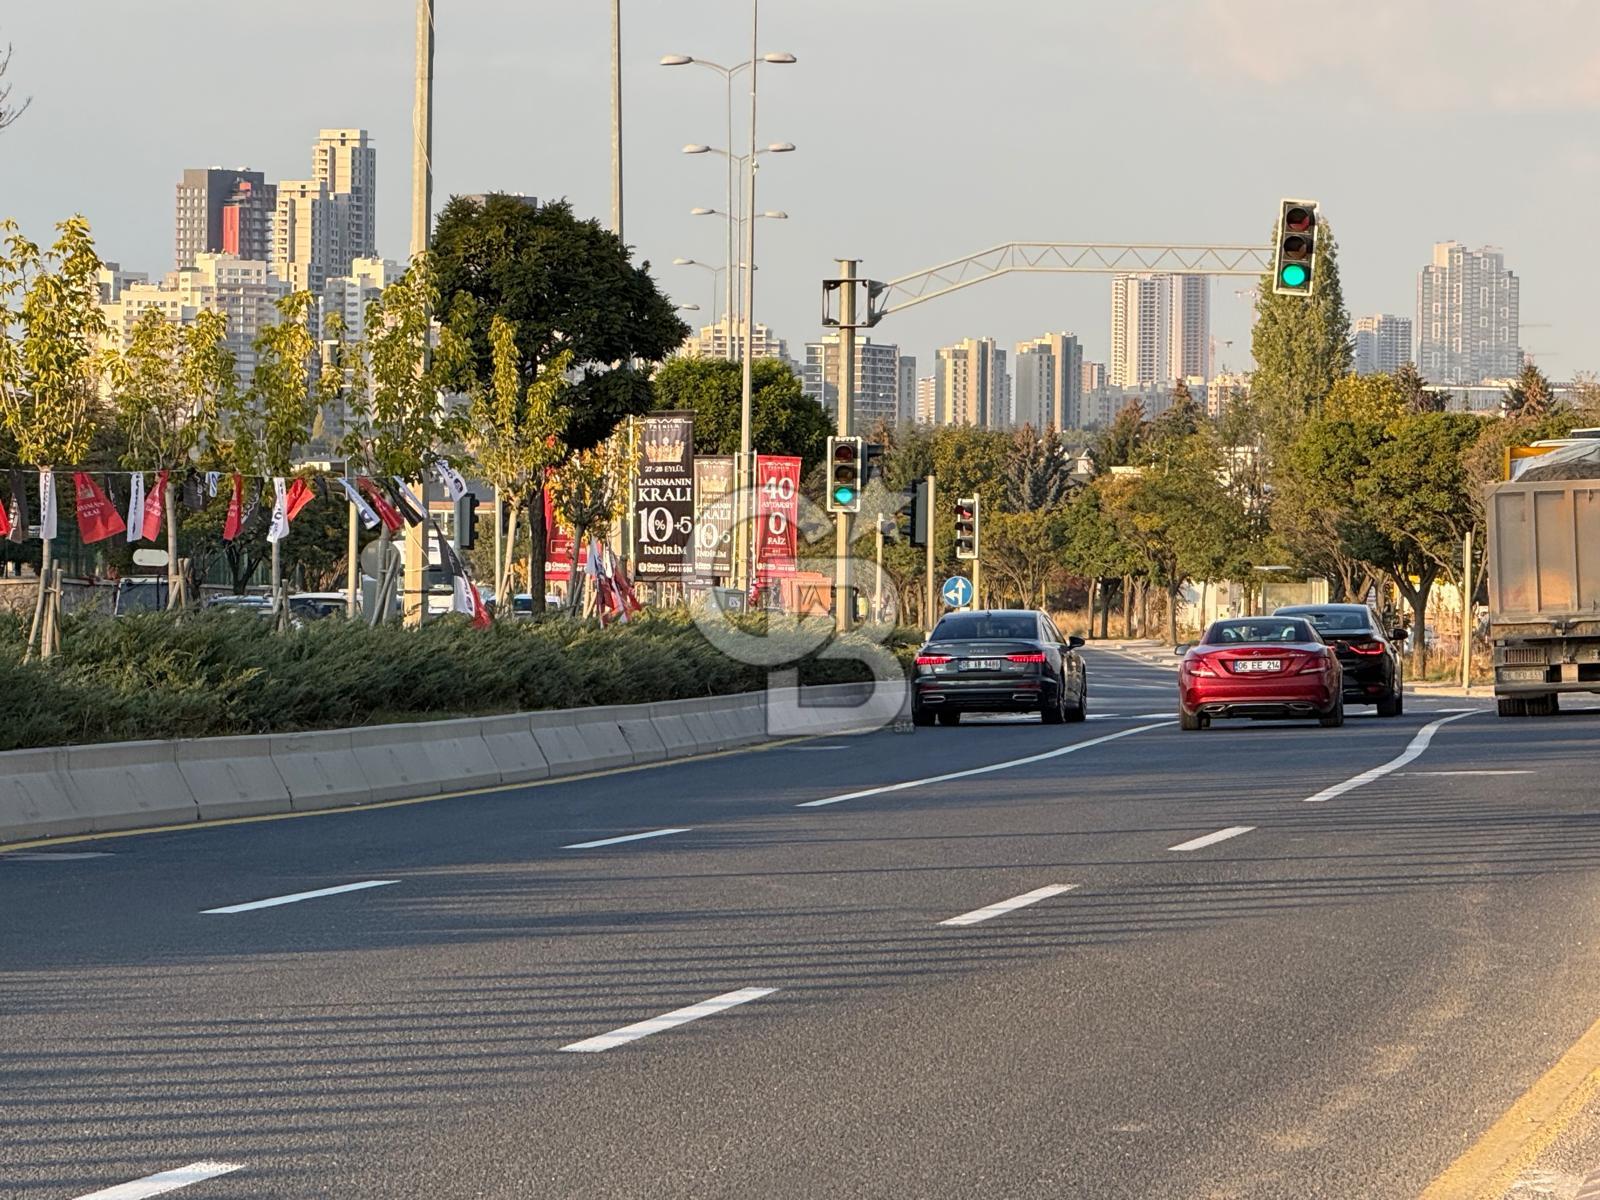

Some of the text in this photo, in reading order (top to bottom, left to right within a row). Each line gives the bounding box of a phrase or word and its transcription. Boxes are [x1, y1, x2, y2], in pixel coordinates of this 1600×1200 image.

[664, 465, 685, 473] EYLÜL
[638, 478, 692, 486] LANSMANIN
[762, 477, 795, 500] 40
[638, 488, 692, 502] KRALI
[638, 506, 674, 543] 10
[769, 512, 787, 535] 0
[767, 536, 787, 545] FAİZ
[643, 544, 688, 555] İNDİRİM
[1238, 660, 1280, 669] 06 EE 214
